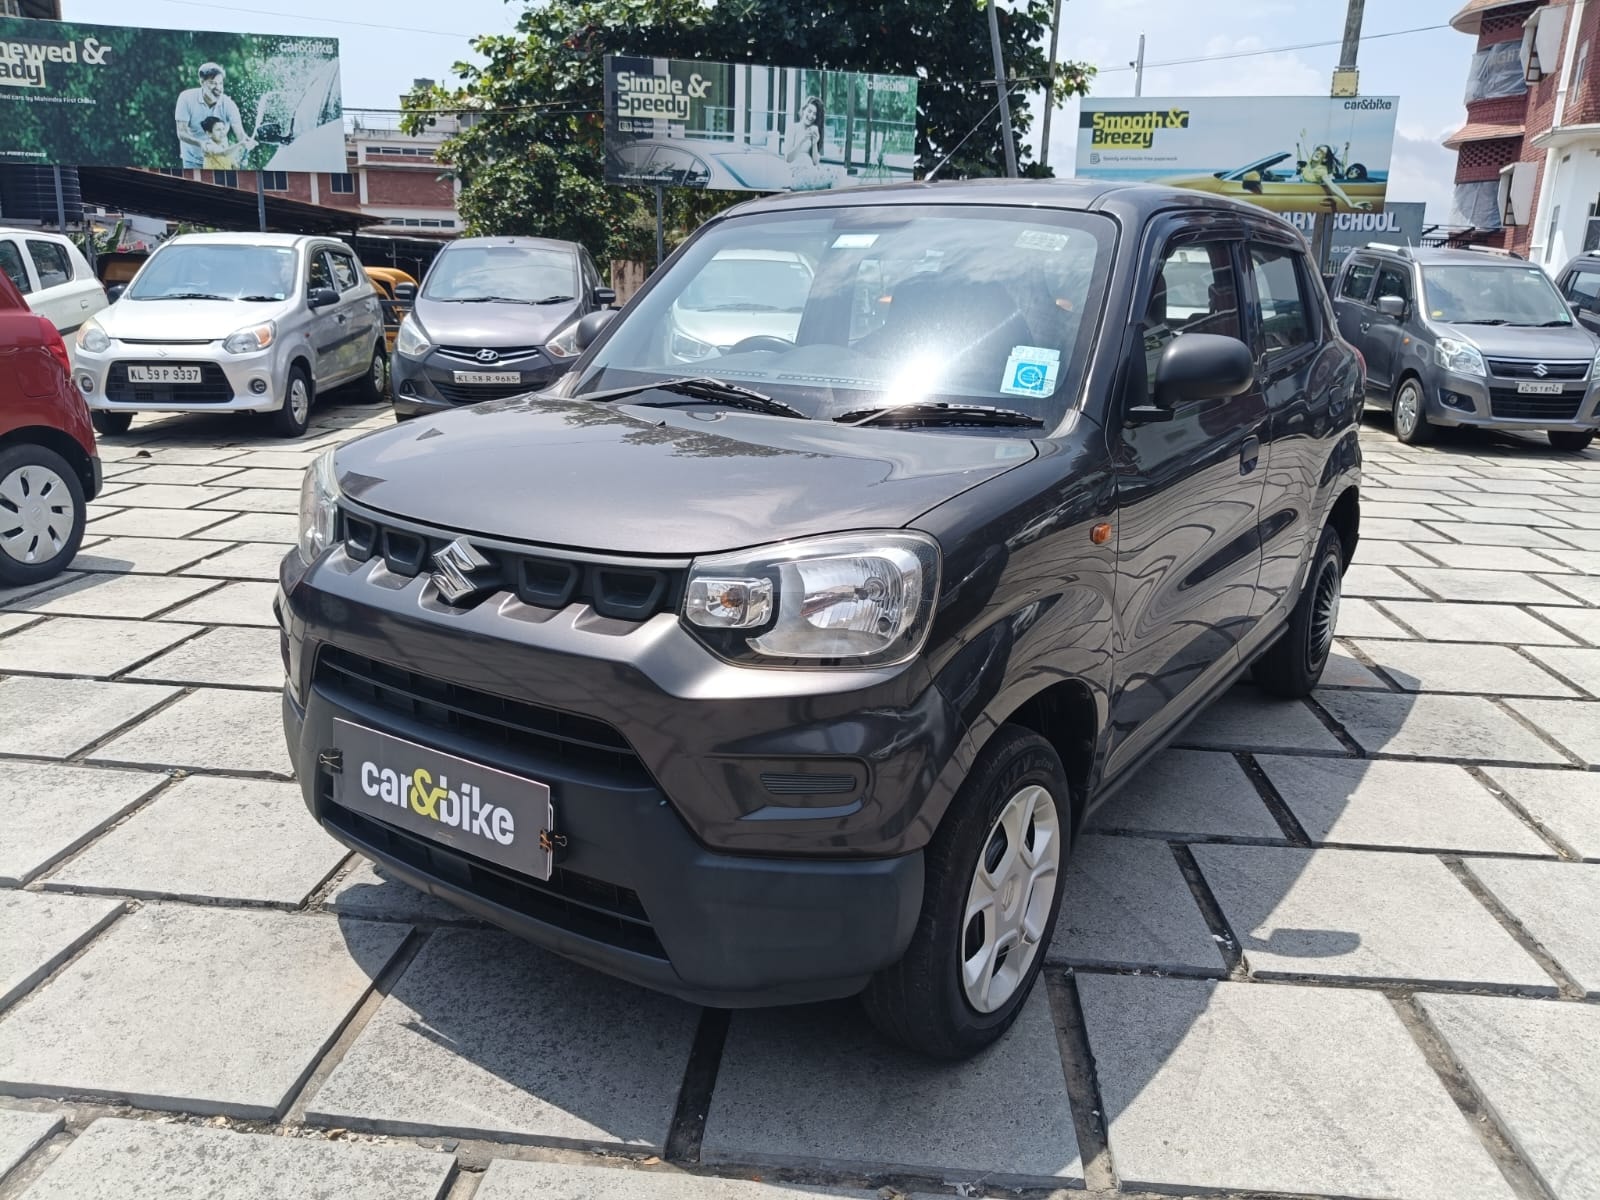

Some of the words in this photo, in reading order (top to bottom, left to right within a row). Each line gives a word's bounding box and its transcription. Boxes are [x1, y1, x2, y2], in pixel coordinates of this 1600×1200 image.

[82, 37, 113, 65] &
[617, 70, 683, 95] Simple
[687, 73, 712, 98] &
[618, 92, 688, 118] Speedy
[1344, 98, 1392, 110] car&bike
[1092, 111, 1163, 129] Smooth
[1165, 106, 1189, 129] &
[1091, 128, 1154, 149] Breezy
[130, 369, 144, 380] KL
[147, 369, 160, 380] 59
[163, 369, 169, 380] P
[172, 369, 198, 381] 9337
[361, 761, 515, 846] car&bike
